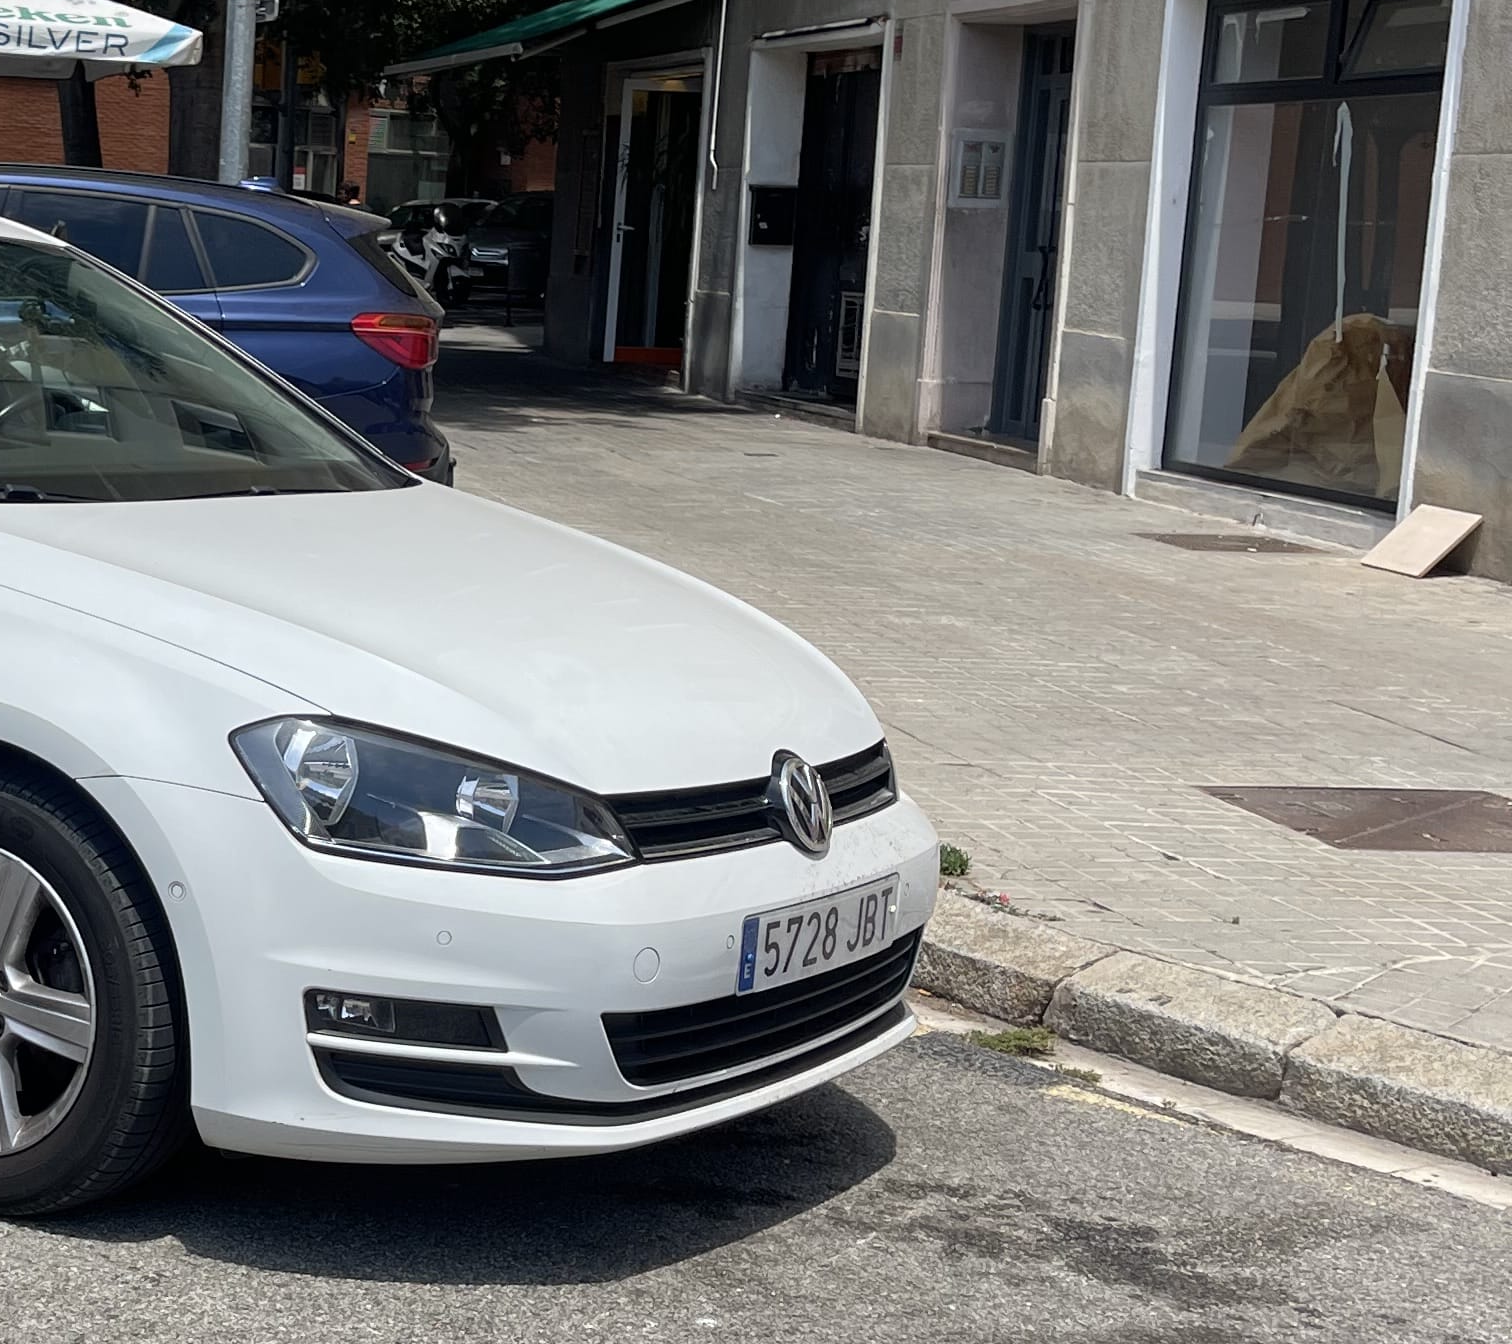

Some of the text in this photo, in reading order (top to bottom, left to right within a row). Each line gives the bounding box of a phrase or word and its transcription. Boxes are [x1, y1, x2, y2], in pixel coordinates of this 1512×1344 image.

[743, 886, 893, 979] E 5728 JBT
